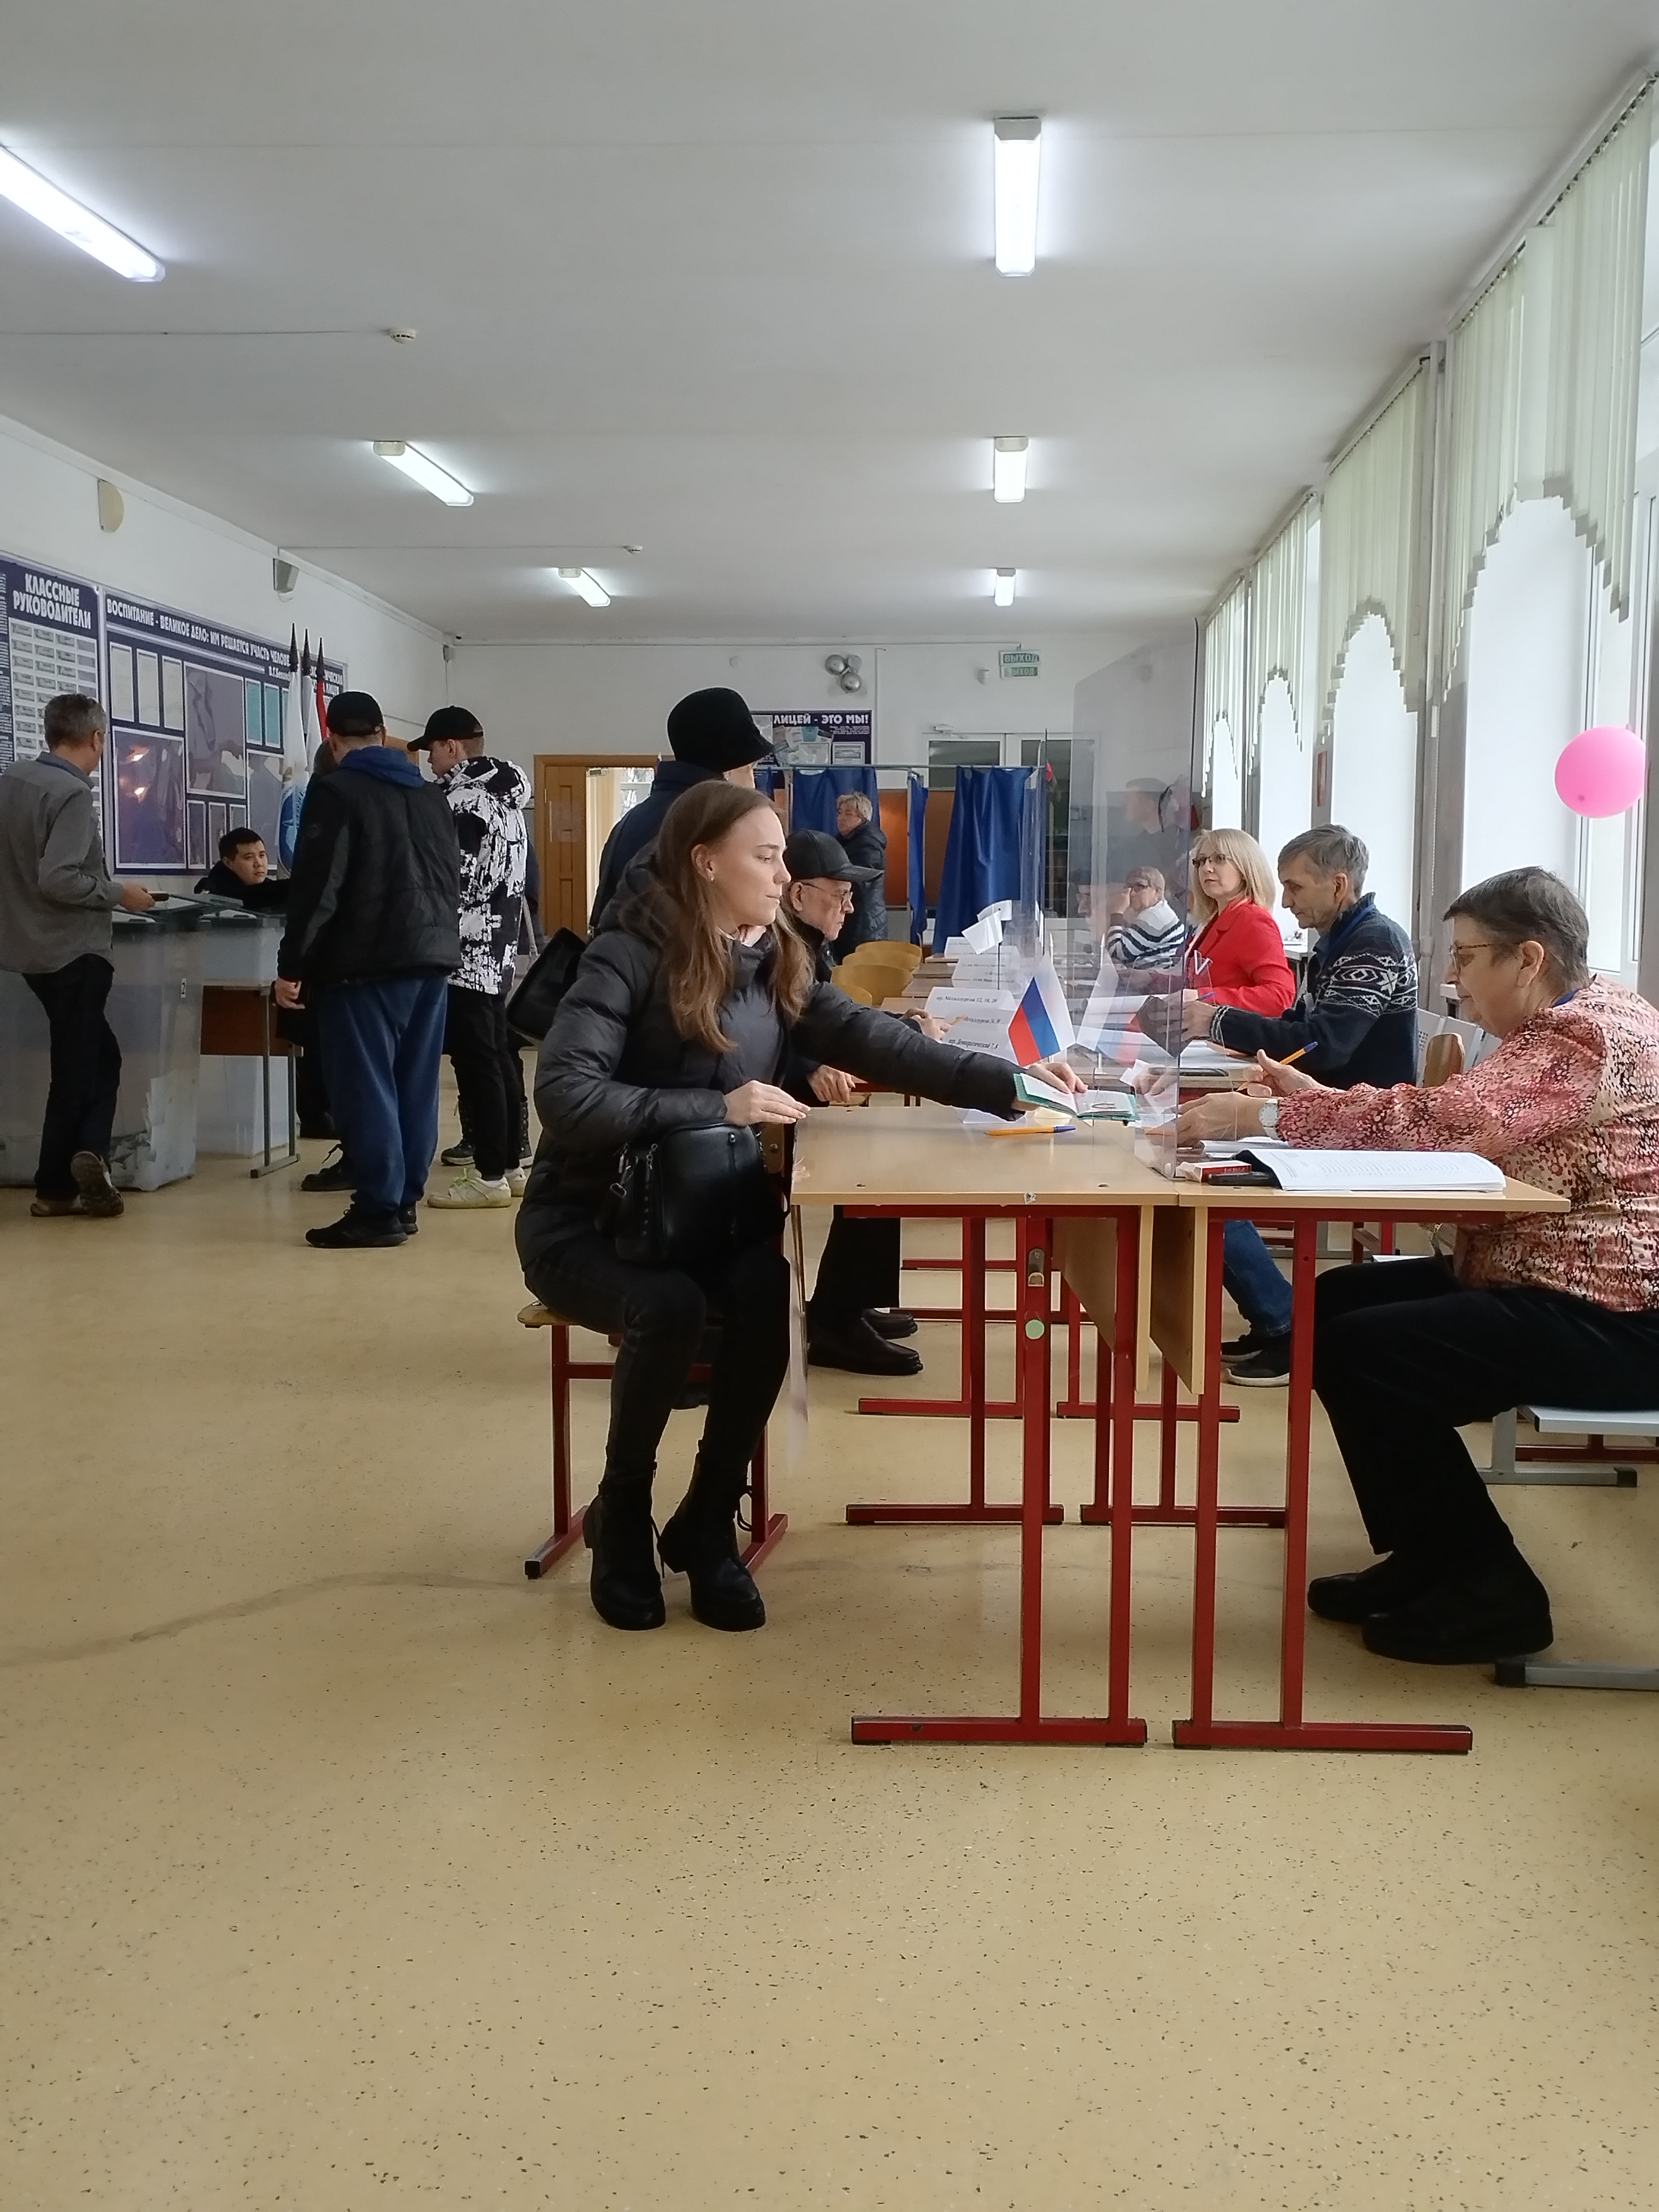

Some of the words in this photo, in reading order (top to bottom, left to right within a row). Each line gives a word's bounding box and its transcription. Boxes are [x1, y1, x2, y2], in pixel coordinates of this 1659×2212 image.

[25, 573, 80, 607] КЛАССНЫЕ
[13, 590, 91, 629] РУКОВОДИТЕЛИ
[107, 598, 154, 626] ВОСПИТАНИЕ
[160, 615, 190, 637] ВЕЛИКОЕ
[191, 625, 210, 643] ДЕЛО:
[270, 650, 292, 667] ЧЕЛОВЕ
[1004, 653, 1037, 663] ВЫХОД
[773, 713, 811, 725] ЛИЦЕЙ
[821, 714, 843, 724] ЭТО
[846, 714, 869, 724] МЫ!
